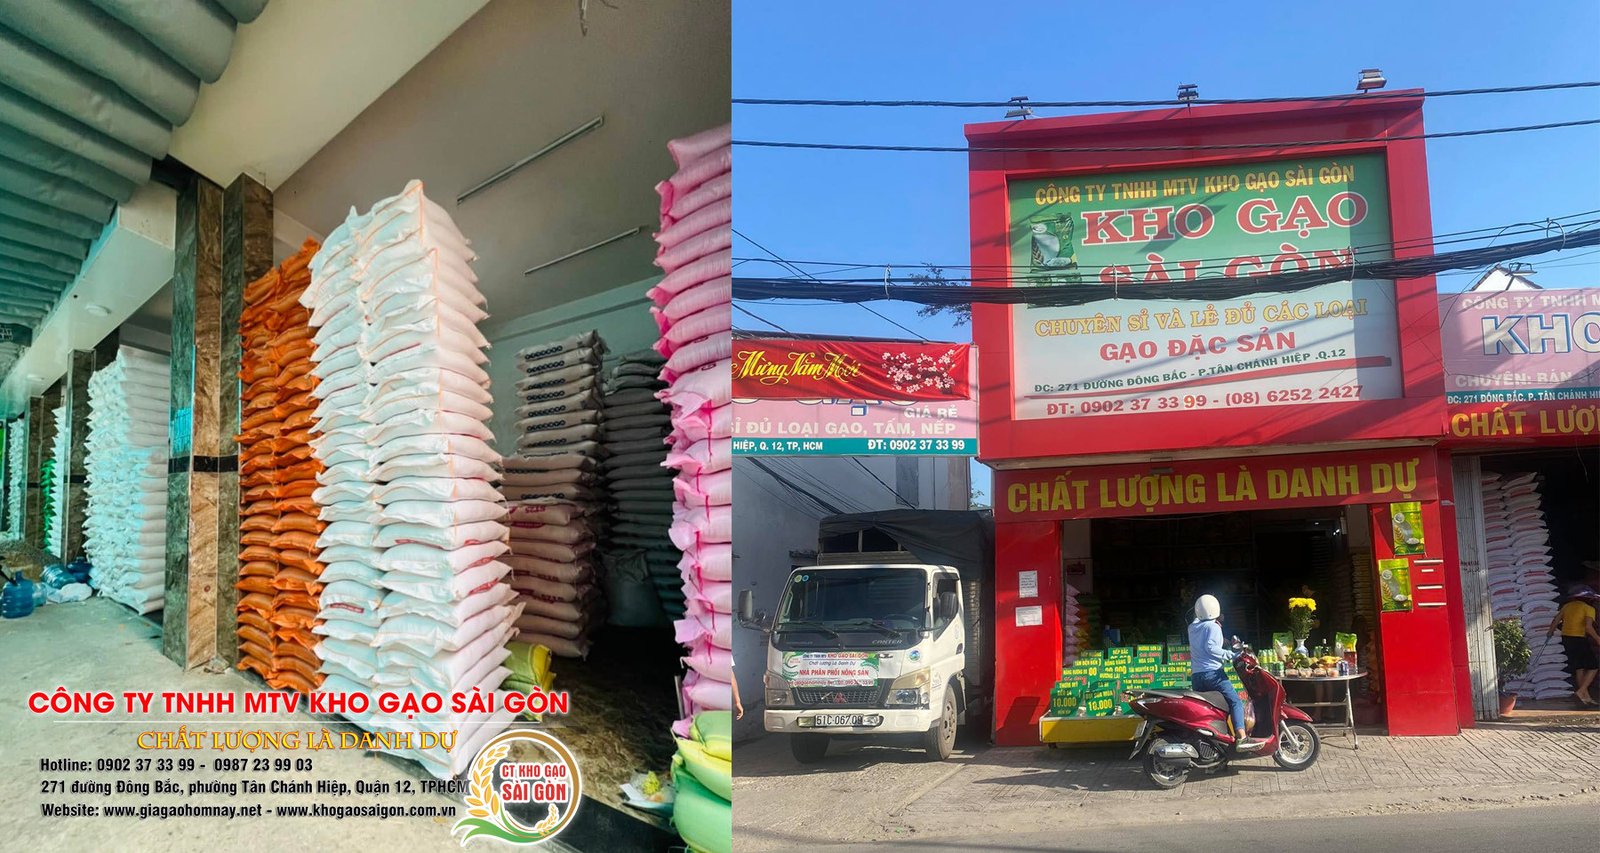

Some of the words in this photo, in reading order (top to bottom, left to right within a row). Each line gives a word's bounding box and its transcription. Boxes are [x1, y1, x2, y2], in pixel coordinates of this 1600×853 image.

[1035, 183, 1081, 206] CÔNG
[1085, 184, 1106, 202] TY
[1112, 180, 1157, 200] TNHH
[1163, 177, 1198, 197] MTV
[1204, 175, 1240, 194] KHO
[1245, 171, 1280, 192] GẠO
[1284, 165, 1313, 187] SÀI
[1318, 162, 1355, 185] GÒN
[1081, 203, 1215, 246] KHO
[1236, 191, 1368, 239] GẠO
[1034, 312, 1121, 337] CHUYÊN
[1128, 308, 1150, 331] SỈ
[1154, 307, 1185, 330] VÀ
[1191, 303, 1219, 327] LẺ
[1225, 301, 1256, 325] ĐỦ
[1263, 300, 1309, 322] CÁC
[1314, 298, 1368, 320] LOẠI
[1462, 296, 1509, 309] CÔNG
[1514, 297, 1534, 309] TY
[1541, 295, 1587, 307] TNHH
[1099, 340, 1158, 363] GẠO
[1167, 334, 1227, 361] ĐẶC
[1236, 326, 1296, 353] SẢN
[1481, 311, 1600, 355] KHO
[732, 350, 788, 385] Mừng
[787, 351, 823, 378] Năm
[815, 351, 864, 382] Mới
[1034, 384, 1054, 393] ĐC:
[1058, 383, 1079, 392] 271
[1083, 378, 1124, 390] ĐƯỜNG
[1127, 375, 1160, 386] ĐÔNG
[1163, 369, 1187, 381] BẮC
[1198, 363, 1234, 377] P.TÂN
[1236, 356, 1278, 371] CHÁNH
[1282, 352, 1311, 364] HIỆP
[903, 404, 931, 419] GIÁ
[937, 404, 957, 418] RẺ
[1046, 403, 1075, 415] ĐT:
[1080, 400, 1124, 414] 0902
[1130, 398, 1151, 411] 37
[1157, 396, 1179, 409] 33
[1183, 394, 1207, 408] 99
[1225, 391, 1260, 406] (08)
[1266, 388, 1312, 403] 6252
[1318, 385, 1363, 399] 2427
[1447, 395, 1461, 404] ĐC:
[1464, 395, 1477, 403] 271
[1480, 392, 1504, 403] ĐÔNG
[1538, 391, 1556, 401] TÂN
[1557, 389, 1588, 400] CHÁNH
[746, 417, 772, 433] ĐỦ
[778, 422, 819, 437] LOẠI
[825, 422, 867, 437] GẠO,
[873, 418, 915, 436] TẤM,
[921, 418, 956, 434] NẾP
[1452, 402, 1526, 437] CHẤT
[1540, 404, 1600, 435] LƯỢ
[733, 440, 757, 452] HIỆP,
[759, 441, 769, 450] Q.
[771, 442, 784, 451] 12,
[787, 441, 800, 451] TP,
[803, 441, 823, 450] HCM
[867, 438, 887, 450] ĐT:
[890, 439, 917, 450] 0902
[919, 440, 932, 450] 37
[935, 440, 949, 450] 33
[951, 440, 965, 450] 99
[1007, 471, 1089, 513] CHẤT
[1100, 472, 1206, 513] LƯỢNG
[1217, 465, 1257, 501] LÀ
[1267, 465, 1360, 500] DANH
[1371, 458, 1420, 498] DỰ
